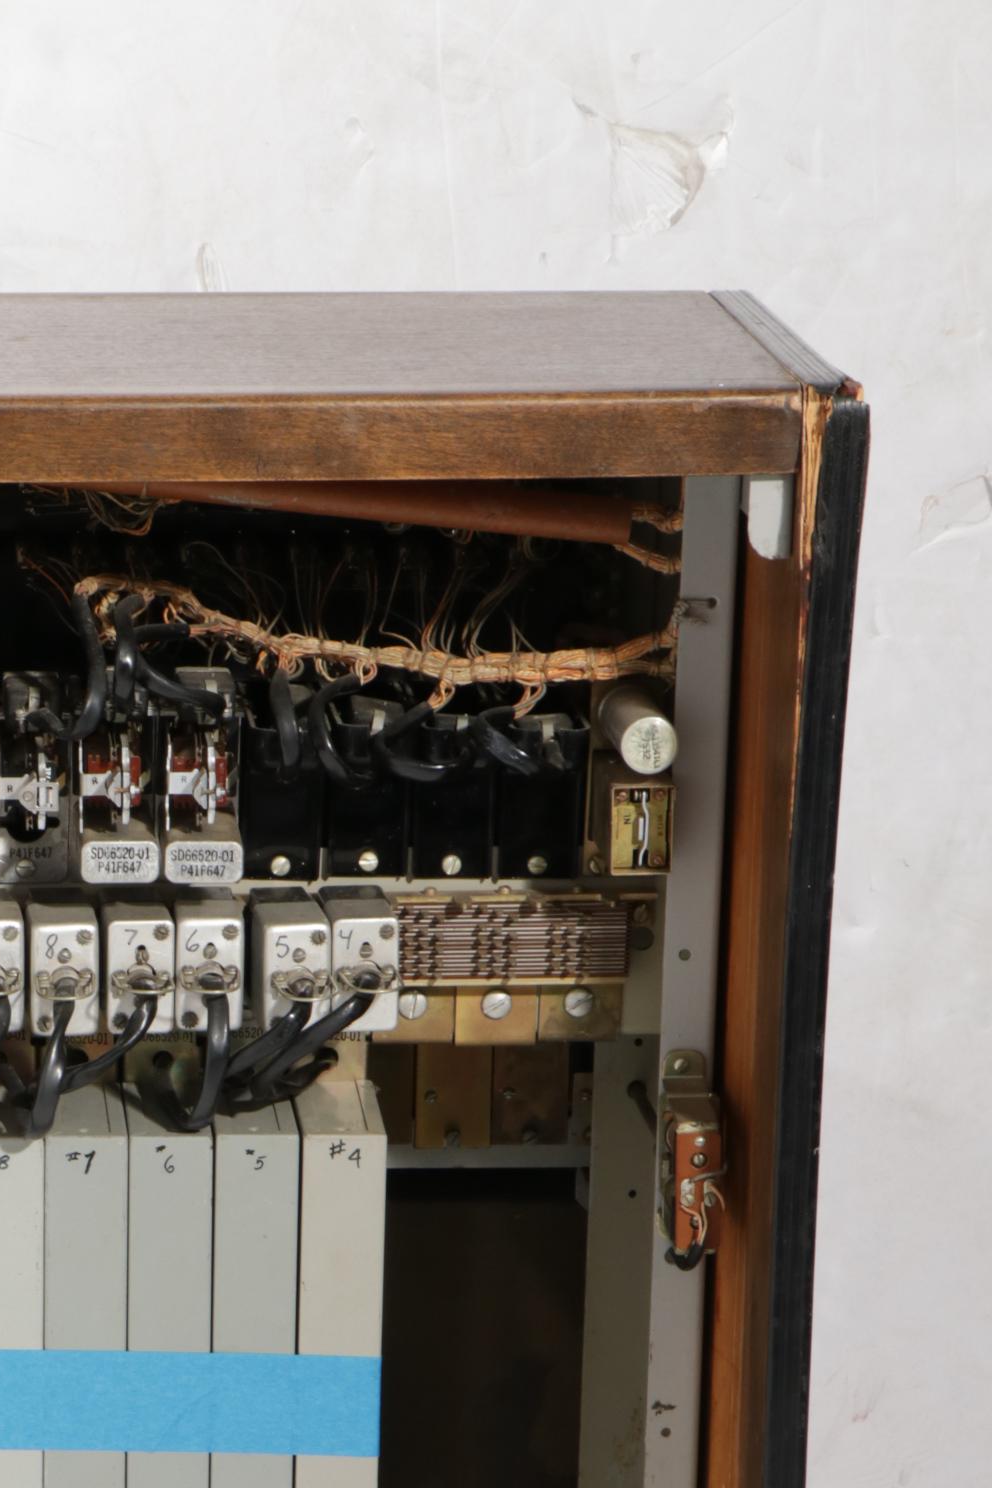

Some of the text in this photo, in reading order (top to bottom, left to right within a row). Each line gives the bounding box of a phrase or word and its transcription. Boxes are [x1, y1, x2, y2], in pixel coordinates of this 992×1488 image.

[91, 847, 150, 860] SD66520-01
[171, 850, 234, 863] SD66520-01
[45, 933, 58, 960] 8
[124, 929, 138, 946] 7
[185, 929, 199, 952] 6
[276, 936, 290, 959] 5
[339, 929, 354, 951] 4
